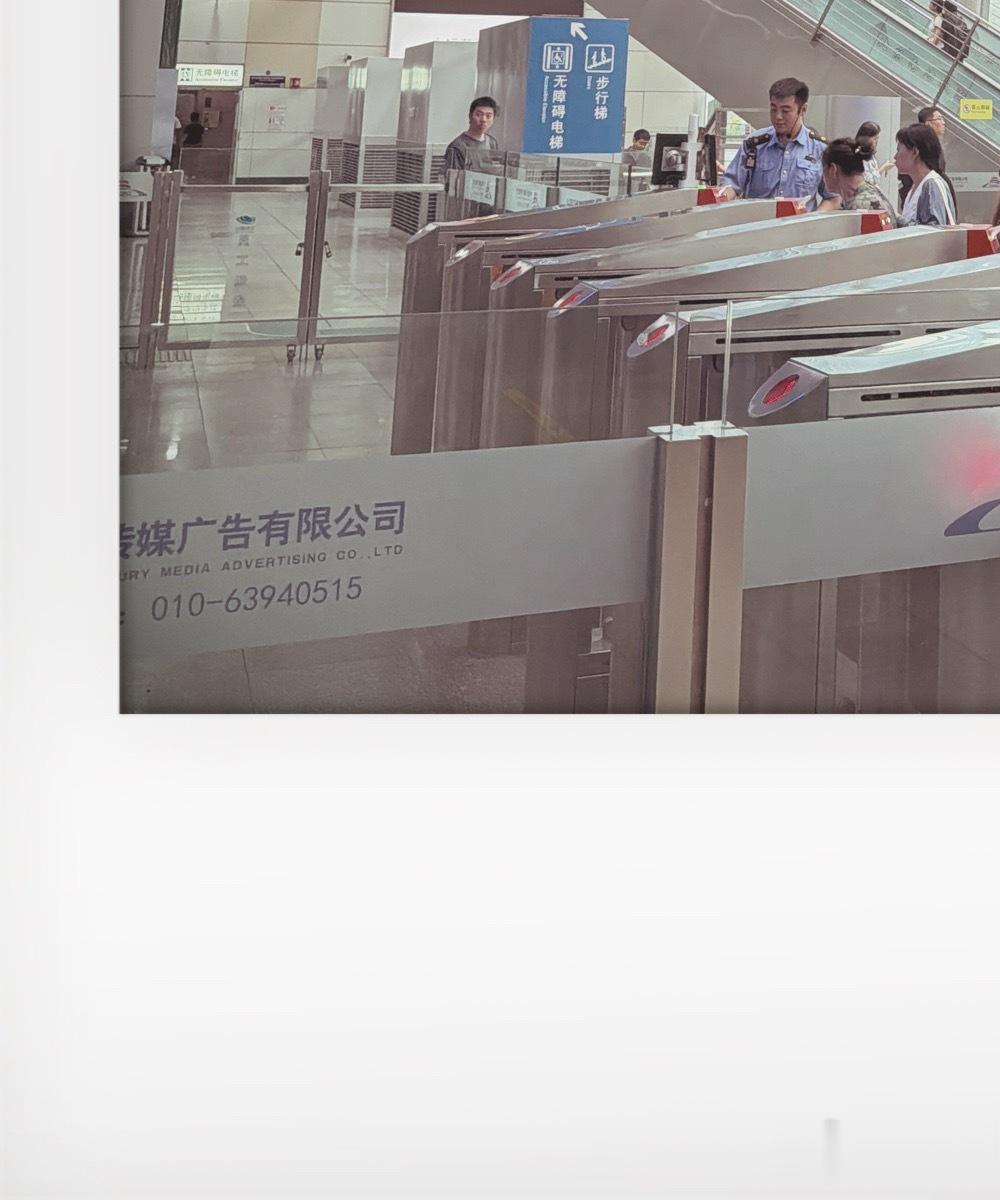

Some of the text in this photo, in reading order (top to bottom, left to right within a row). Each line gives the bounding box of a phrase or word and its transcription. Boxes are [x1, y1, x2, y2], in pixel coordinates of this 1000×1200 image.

[549, 74, 568, 150] 无障碍电梯
[594, 76, 610, 120] 步行梯
[160, 563, 210, 577] MEDIA
[222, 552, 327, 571] ADVERTISING
[151, 575, 362, 621] 010-63940515
